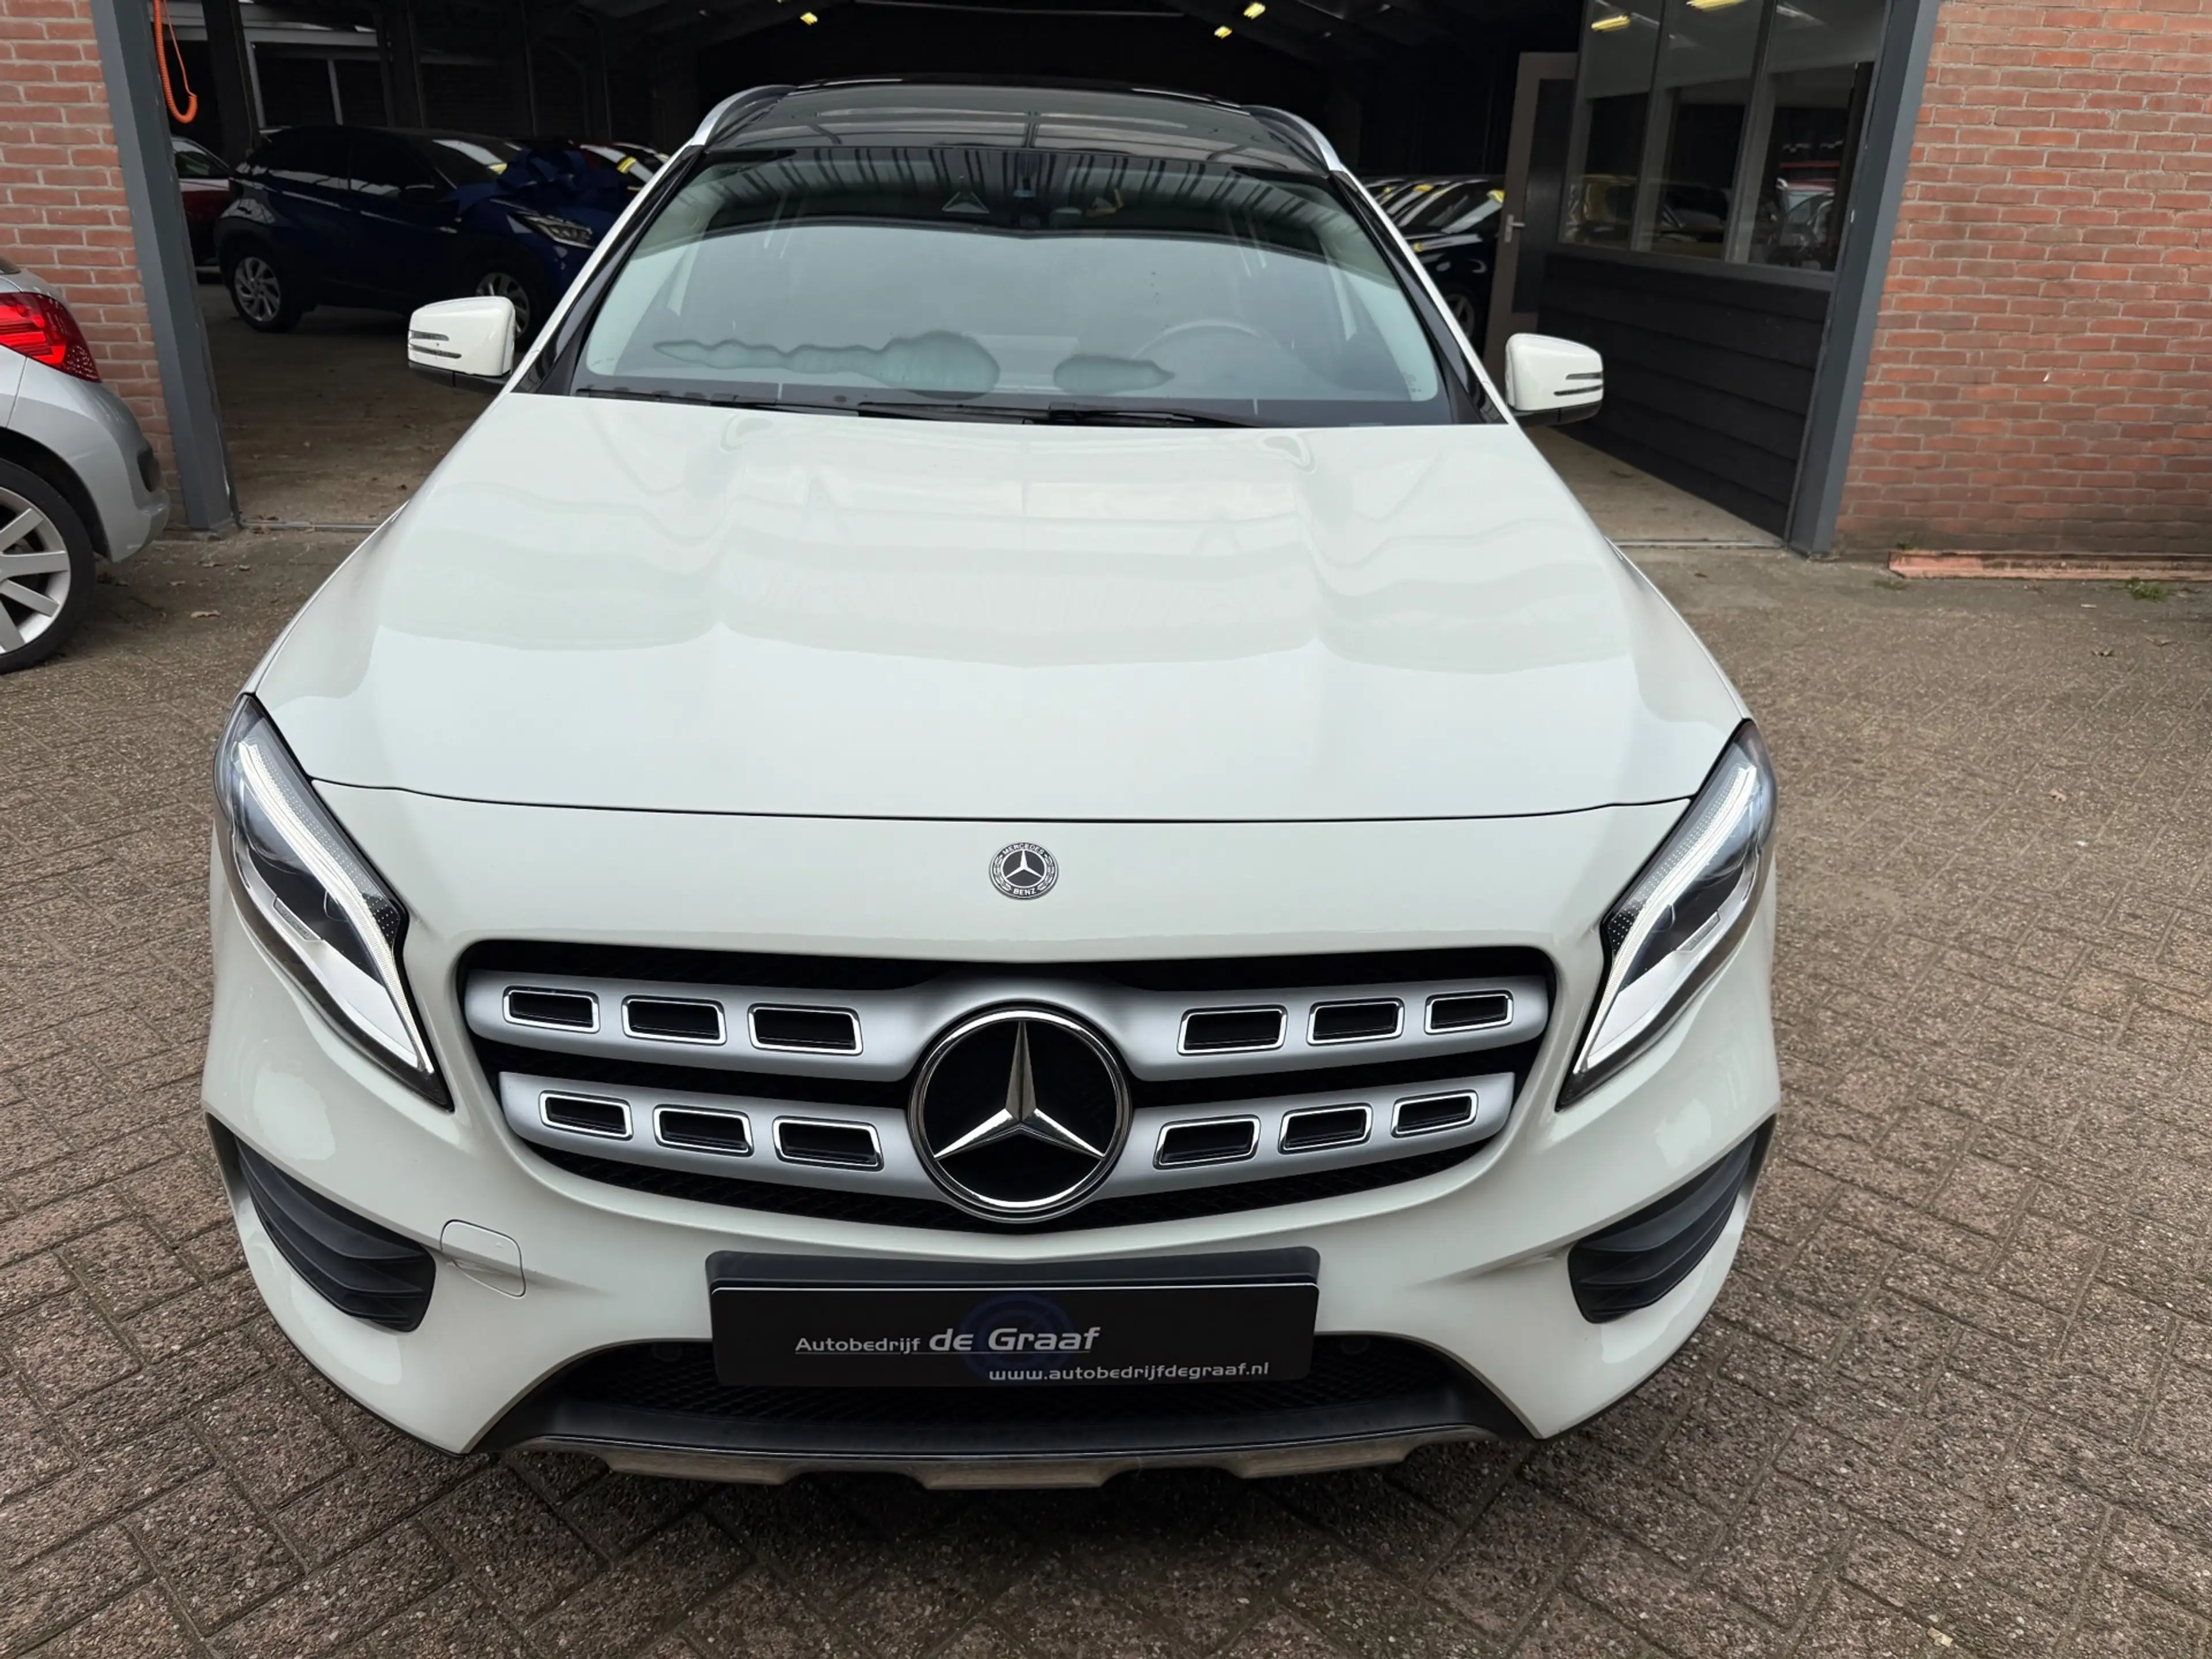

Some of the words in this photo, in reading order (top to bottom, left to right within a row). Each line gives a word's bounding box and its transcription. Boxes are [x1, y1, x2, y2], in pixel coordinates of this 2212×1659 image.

[1002, 843, 1045, 855] MERCEDES
[795, 1338, 921, 1354] Autobedrijf
[929, 1328, 974, 1351] de
[988, 1327, 1101, 1351] Graaf
[989, 1362, 1270, 1381] www.autobedrijfdegraaf.nl
